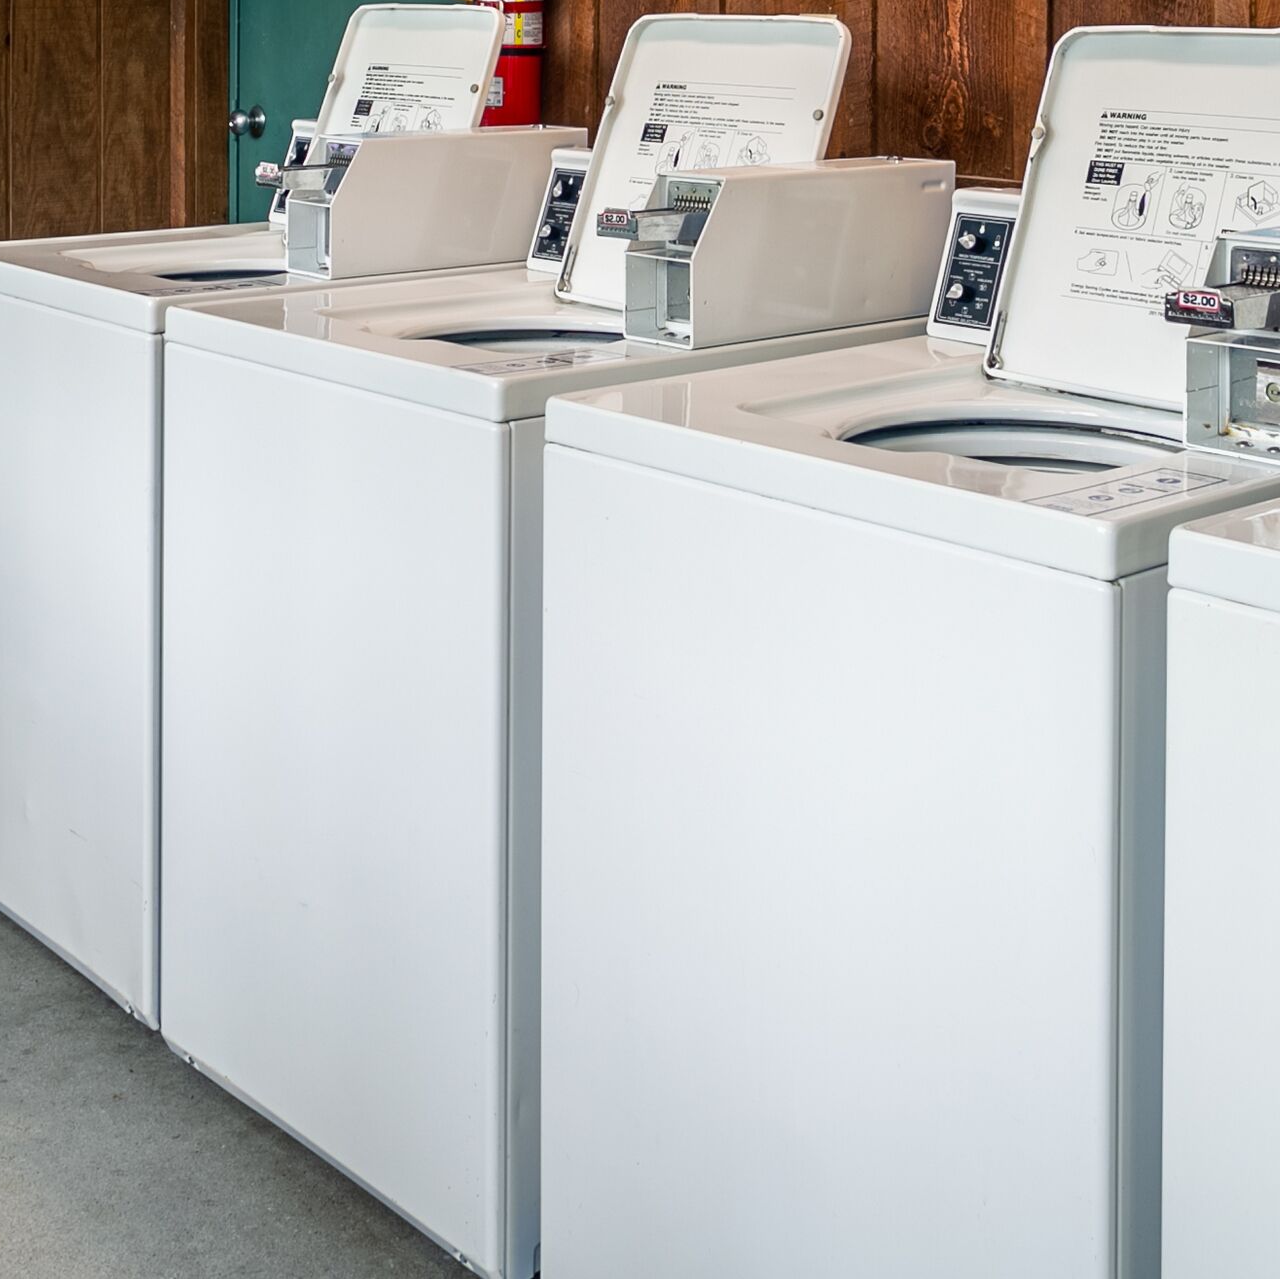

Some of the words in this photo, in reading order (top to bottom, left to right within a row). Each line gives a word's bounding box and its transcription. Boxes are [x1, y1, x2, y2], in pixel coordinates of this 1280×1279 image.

[1109, 112, 1147, 120] WARNING
[605, 214, 625, 224] $2.00
[1182, 294, 1216, 307] $2.00
